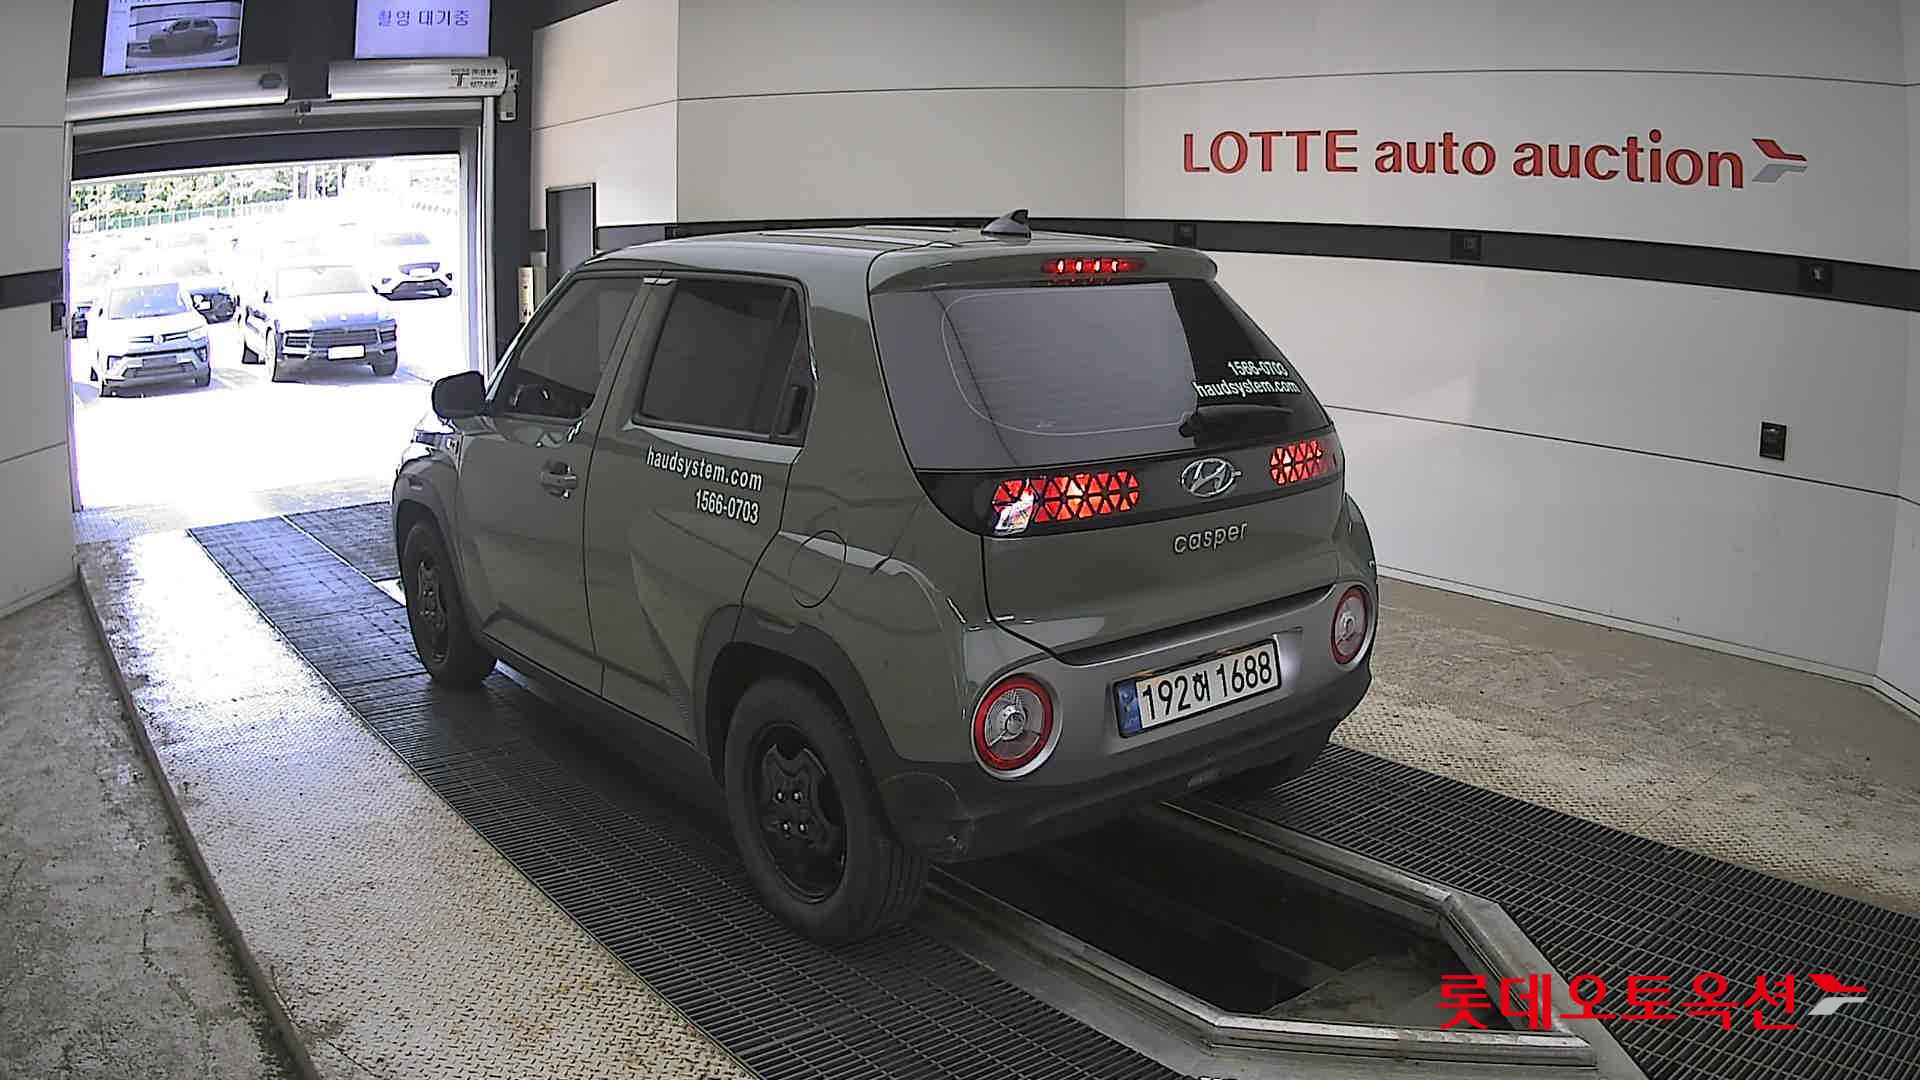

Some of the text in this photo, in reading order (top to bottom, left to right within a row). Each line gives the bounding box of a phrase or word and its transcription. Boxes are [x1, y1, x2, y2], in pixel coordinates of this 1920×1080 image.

[418, 9, 469, 27] 대기중
[1184, 129, 1744, 189] LOTTE auto auction
[1192, 379, 1301, 398] haudsystem.com
[646, 445, 763, 491] haudsystem.com
[695, 488, 759, 524] 1566-0703
[1174, 521, 1248, 553] casper
[1142, 651, 1272, 720] 192허 1688
